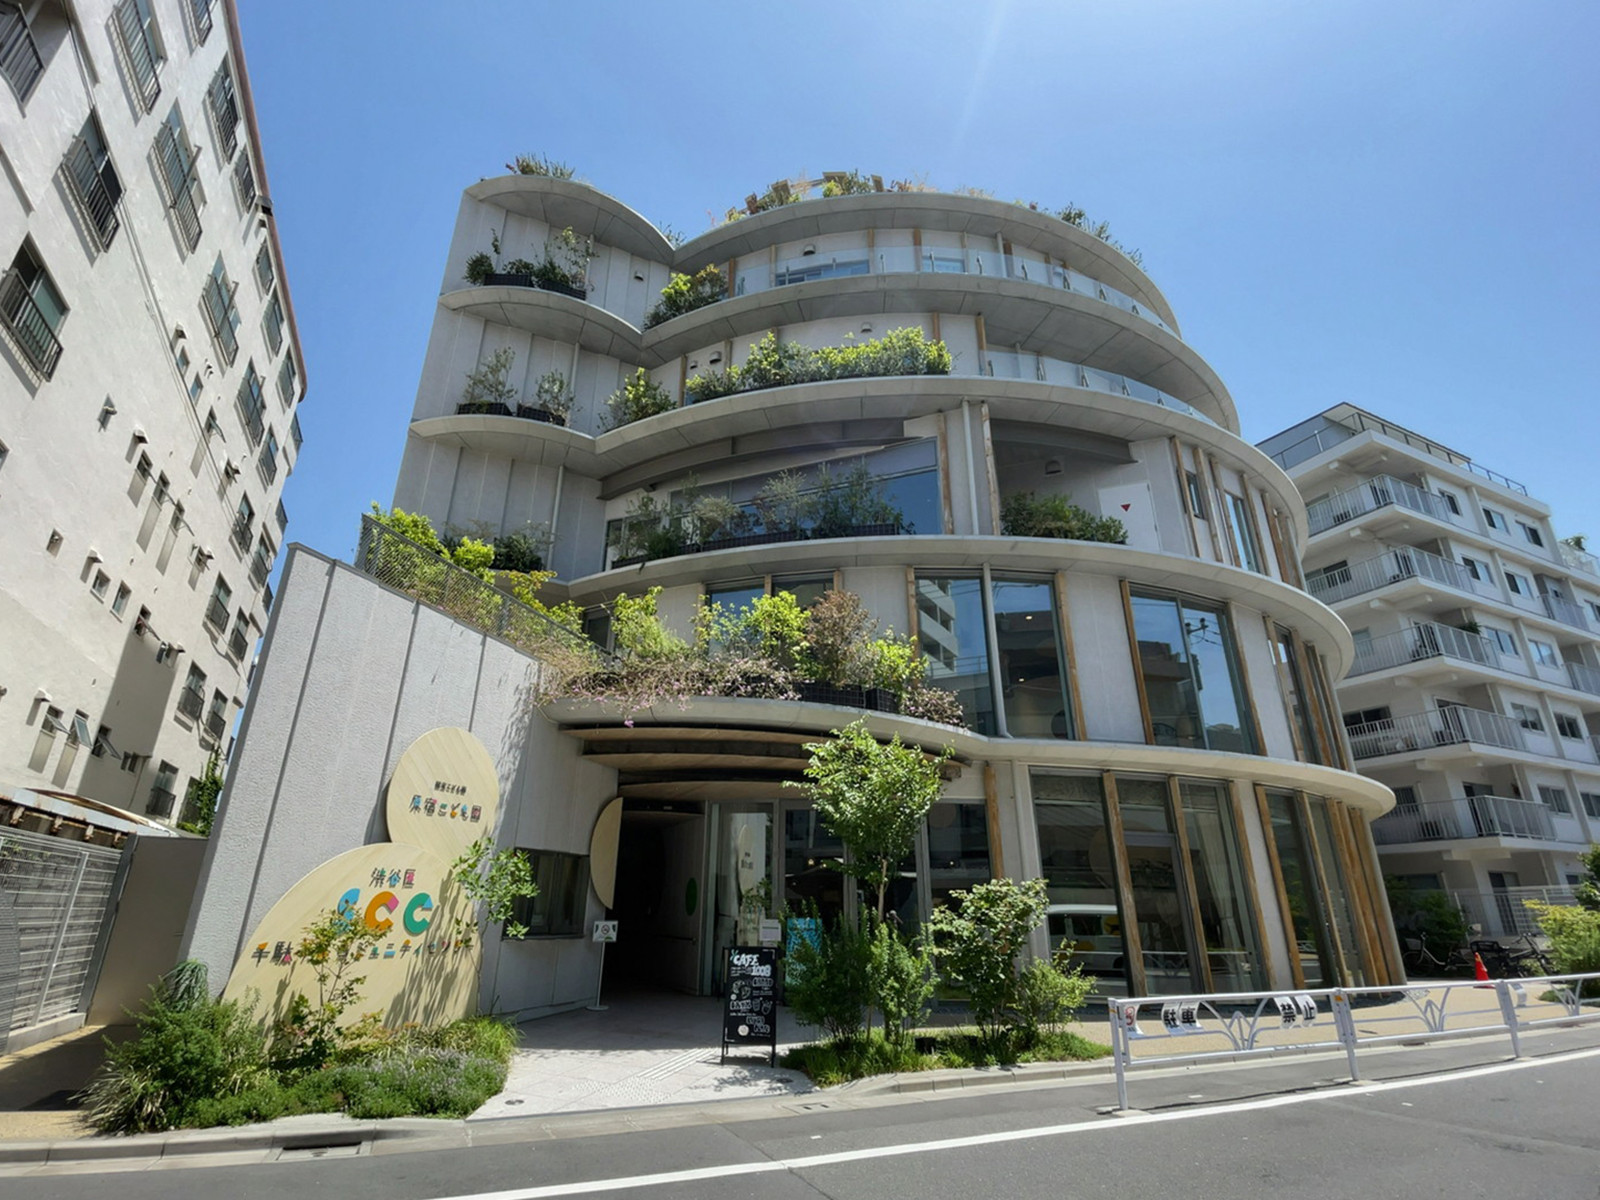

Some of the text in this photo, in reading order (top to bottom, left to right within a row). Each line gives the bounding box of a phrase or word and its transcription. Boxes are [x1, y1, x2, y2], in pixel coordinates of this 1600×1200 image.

[409, 794, 481, 823] 原宿こども園
[368, 867, 416, 889] 渋谷区
[337, 887, 434, 937] CCC
[733, 953, 760, 966] CAFE
[1163, 1002, 1316, 1029] 駐車 禁止
